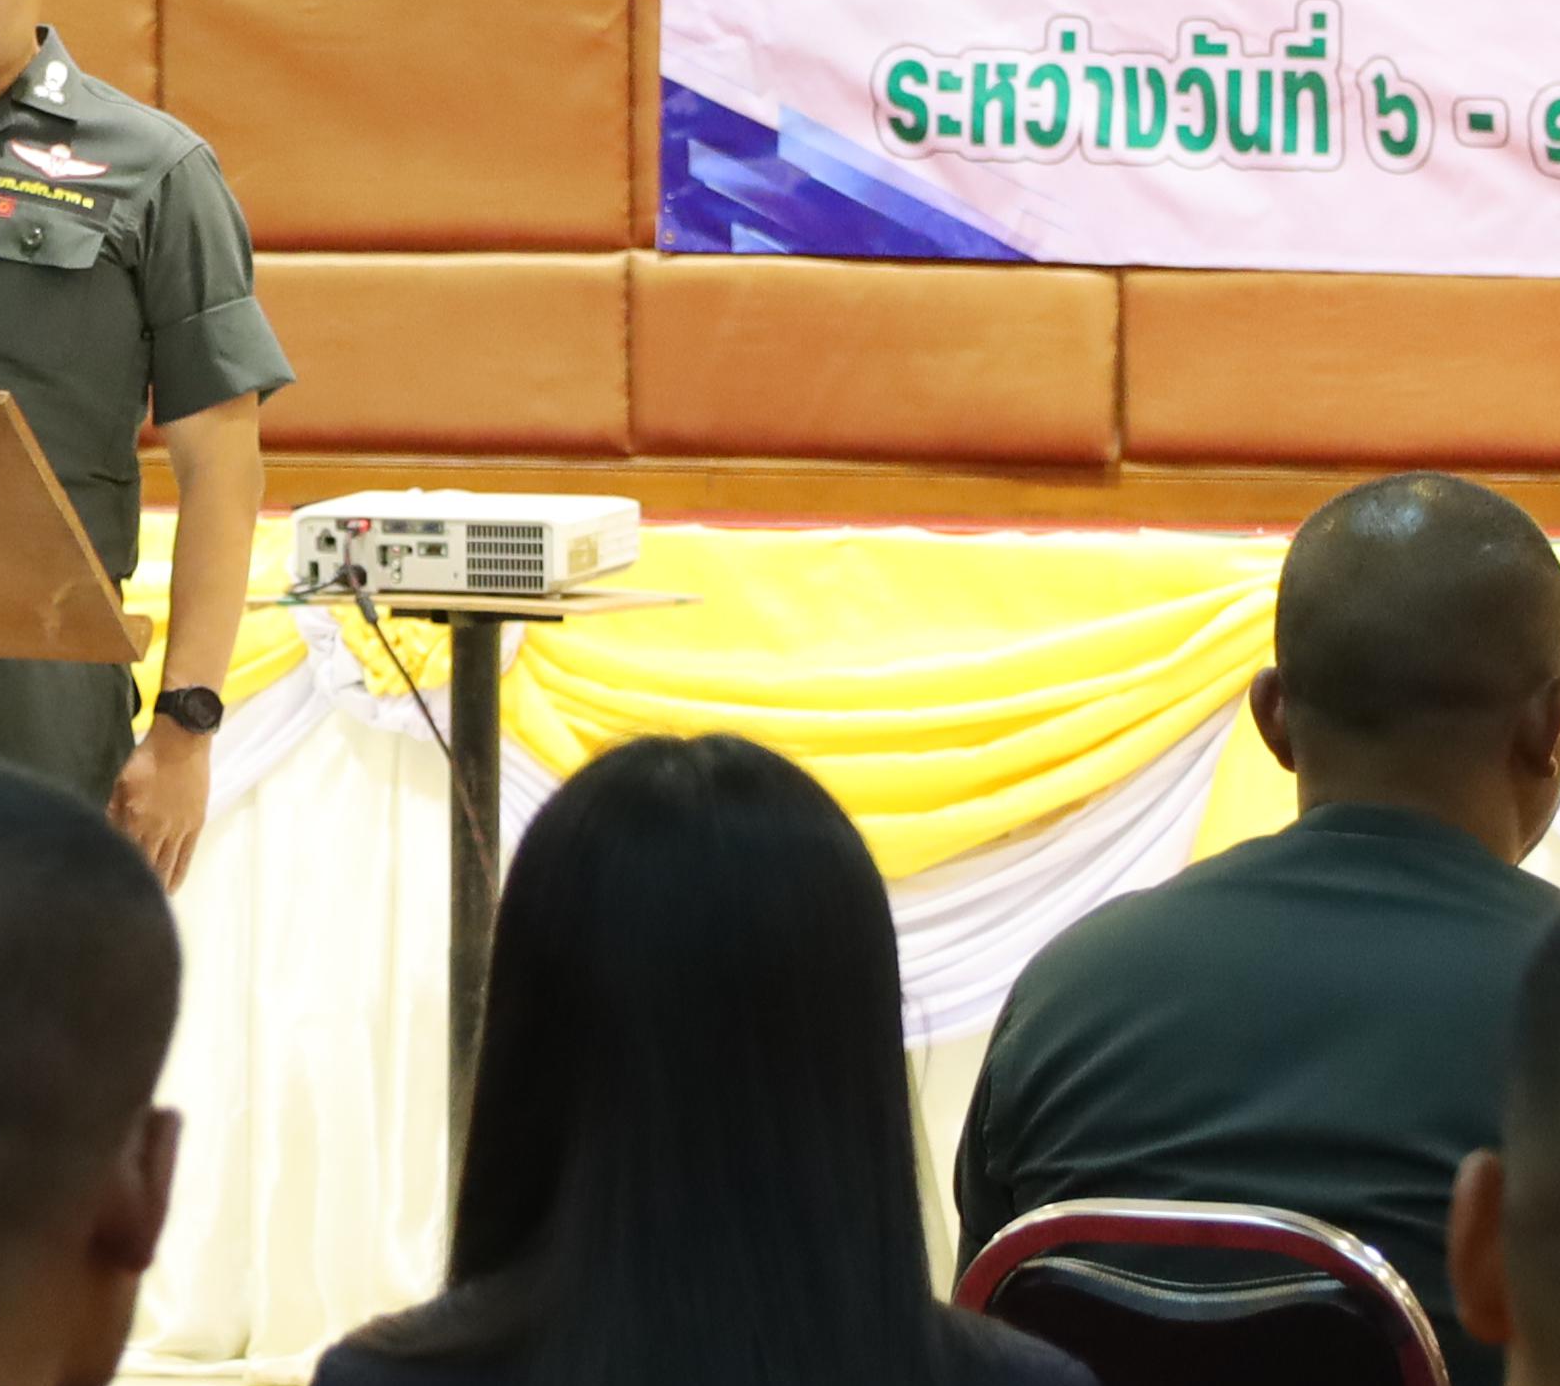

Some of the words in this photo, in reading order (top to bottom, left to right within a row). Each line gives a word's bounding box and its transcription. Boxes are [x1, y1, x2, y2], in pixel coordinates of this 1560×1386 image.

[885, 10, 1331, 156] ระหว่างวันที่
[1373, 73, 1420, 157] ๖
